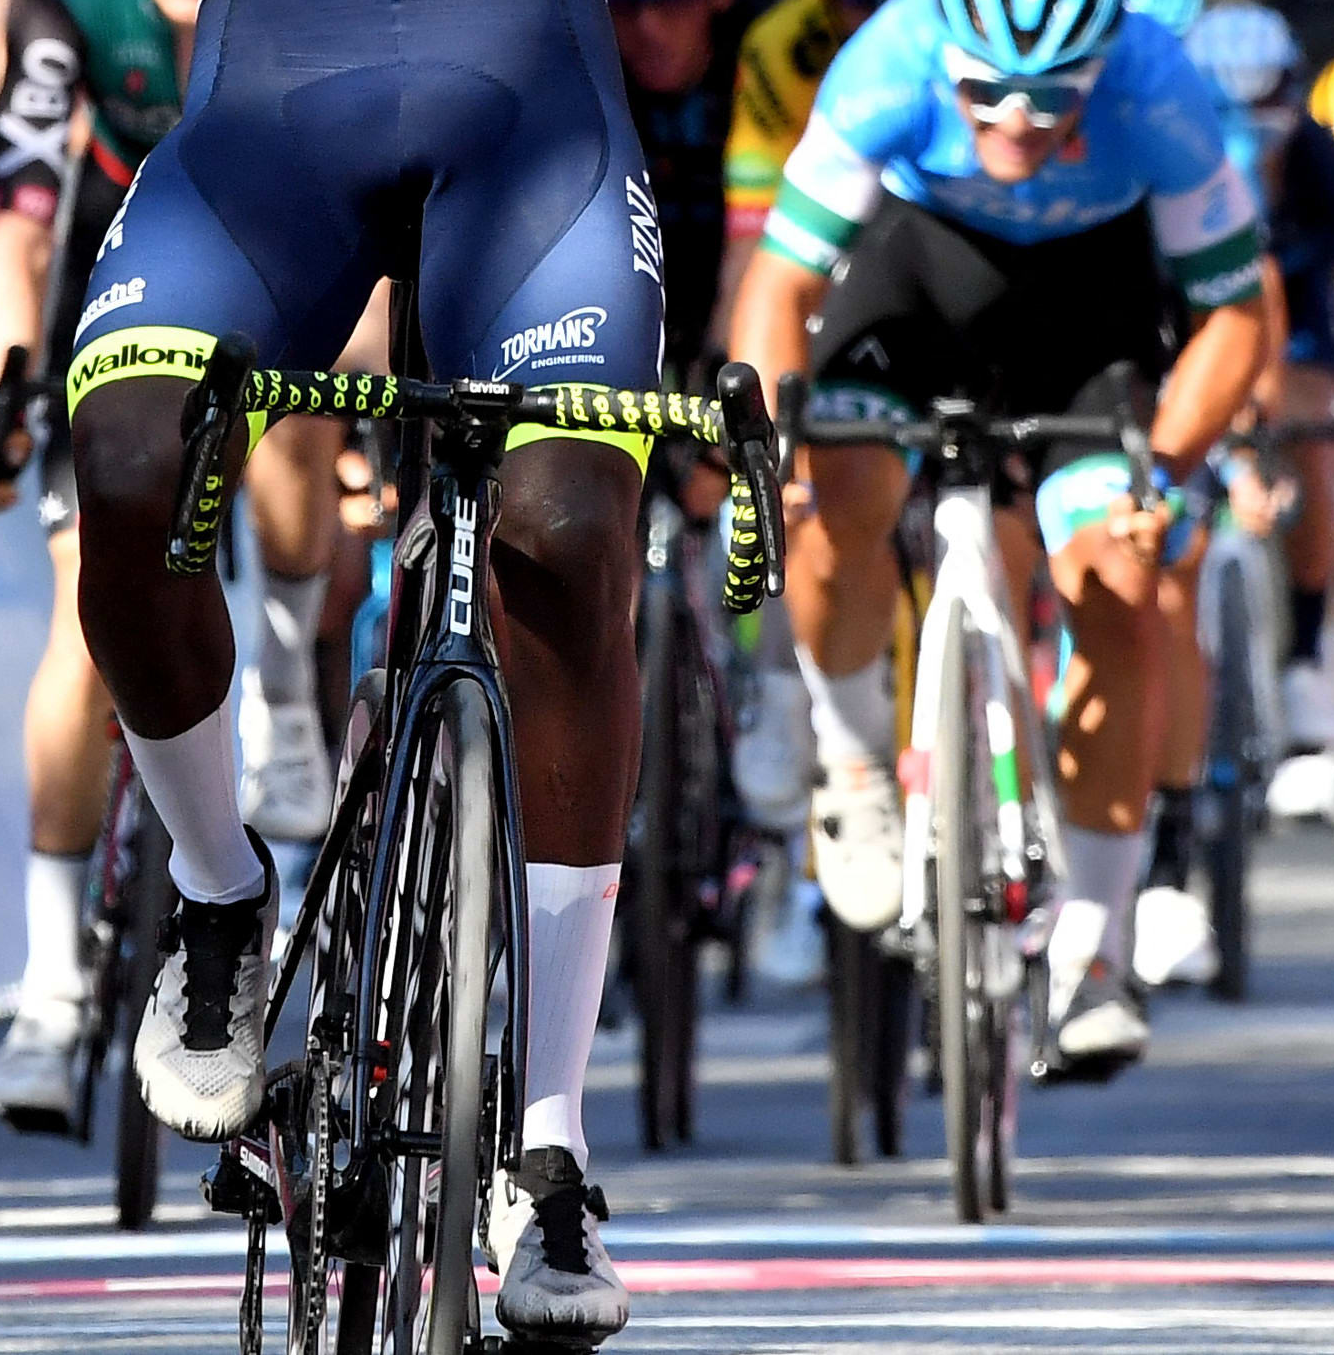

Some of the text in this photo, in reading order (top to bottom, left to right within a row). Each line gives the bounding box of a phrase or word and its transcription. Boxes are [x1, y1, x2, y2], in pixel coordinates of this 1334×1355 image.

[500, 316, 597, 366] TORMANS
[530, 353, 606, 370] ENGINEERING
[72, 343, 208, 393] Walloni
[449, 495, 478, 637] CUBE
